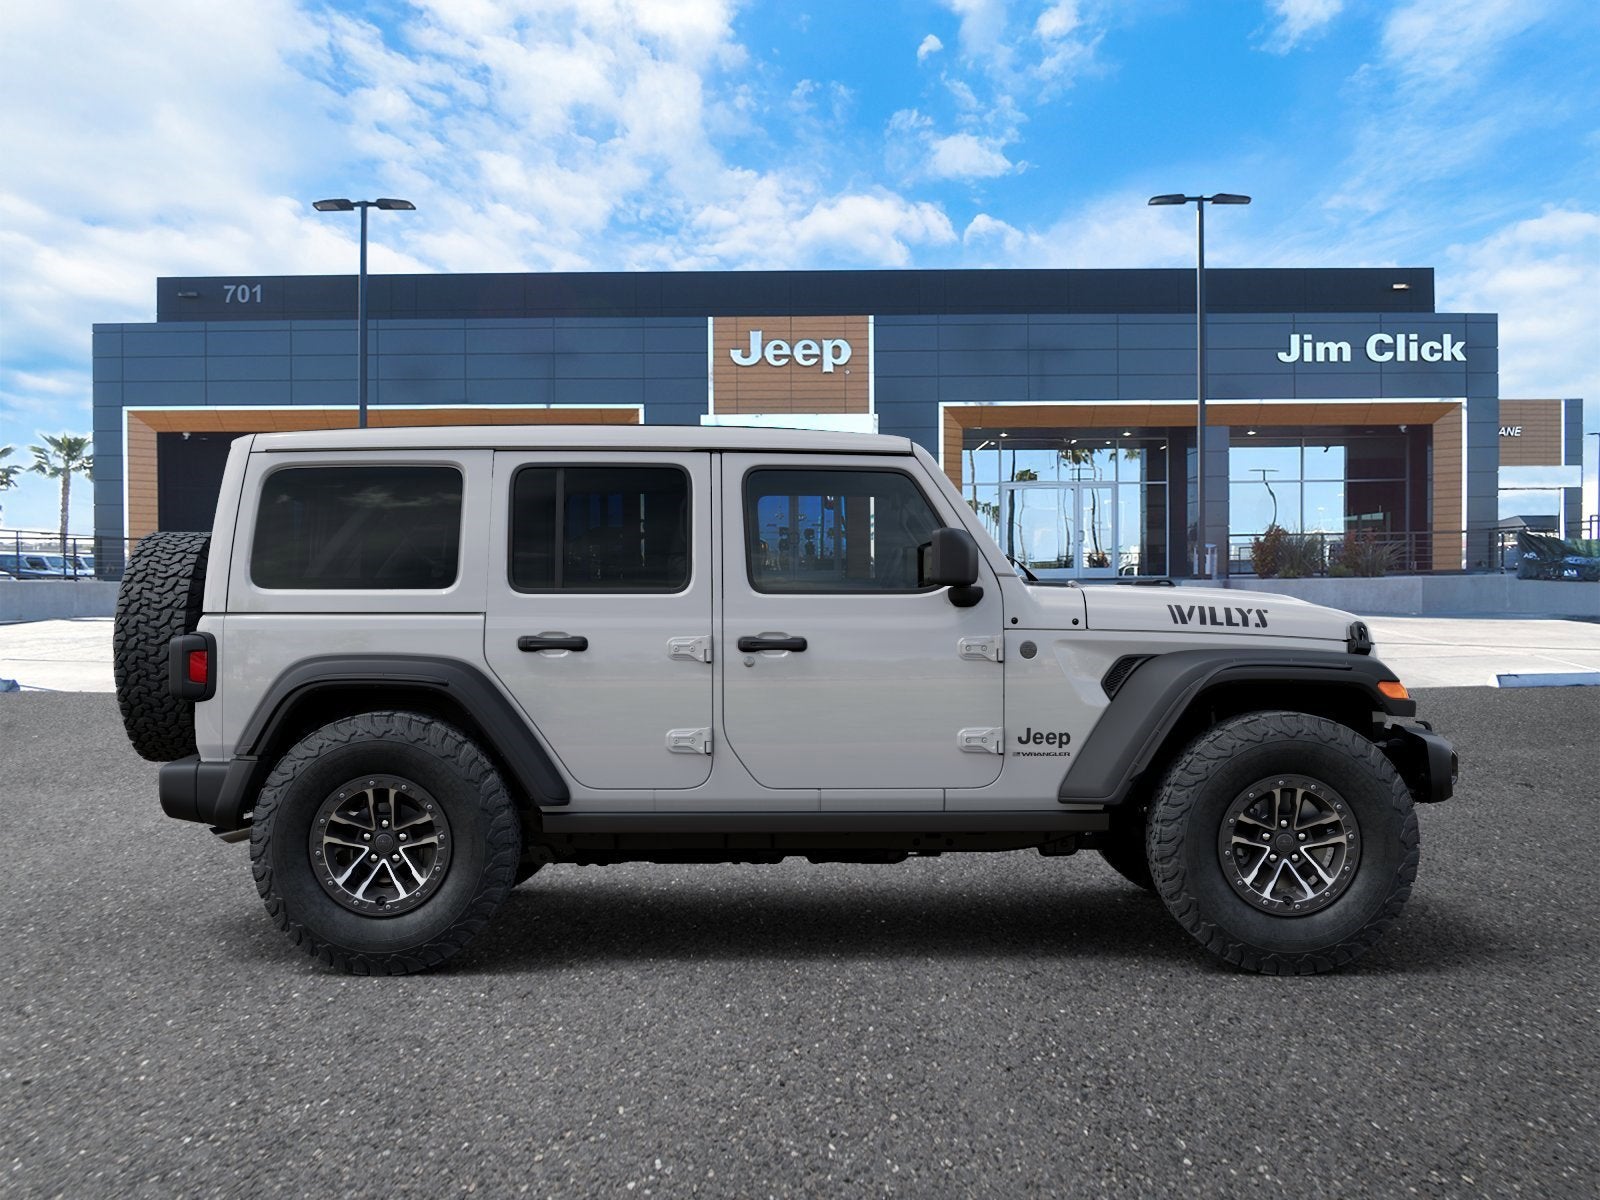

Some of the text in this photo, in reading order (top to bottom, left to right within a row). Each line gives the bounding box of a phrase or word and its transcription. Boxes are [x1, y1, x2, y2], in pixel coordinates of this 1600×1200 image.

[223, 284, 262, 303] 701
[730, 330, 852, 373] Jeep
[1277, 333, 1467, 362] Jim Click
[1167, 604, 1268, 628] WILLYS
[1017, 727, 1071, 748] Jeep
